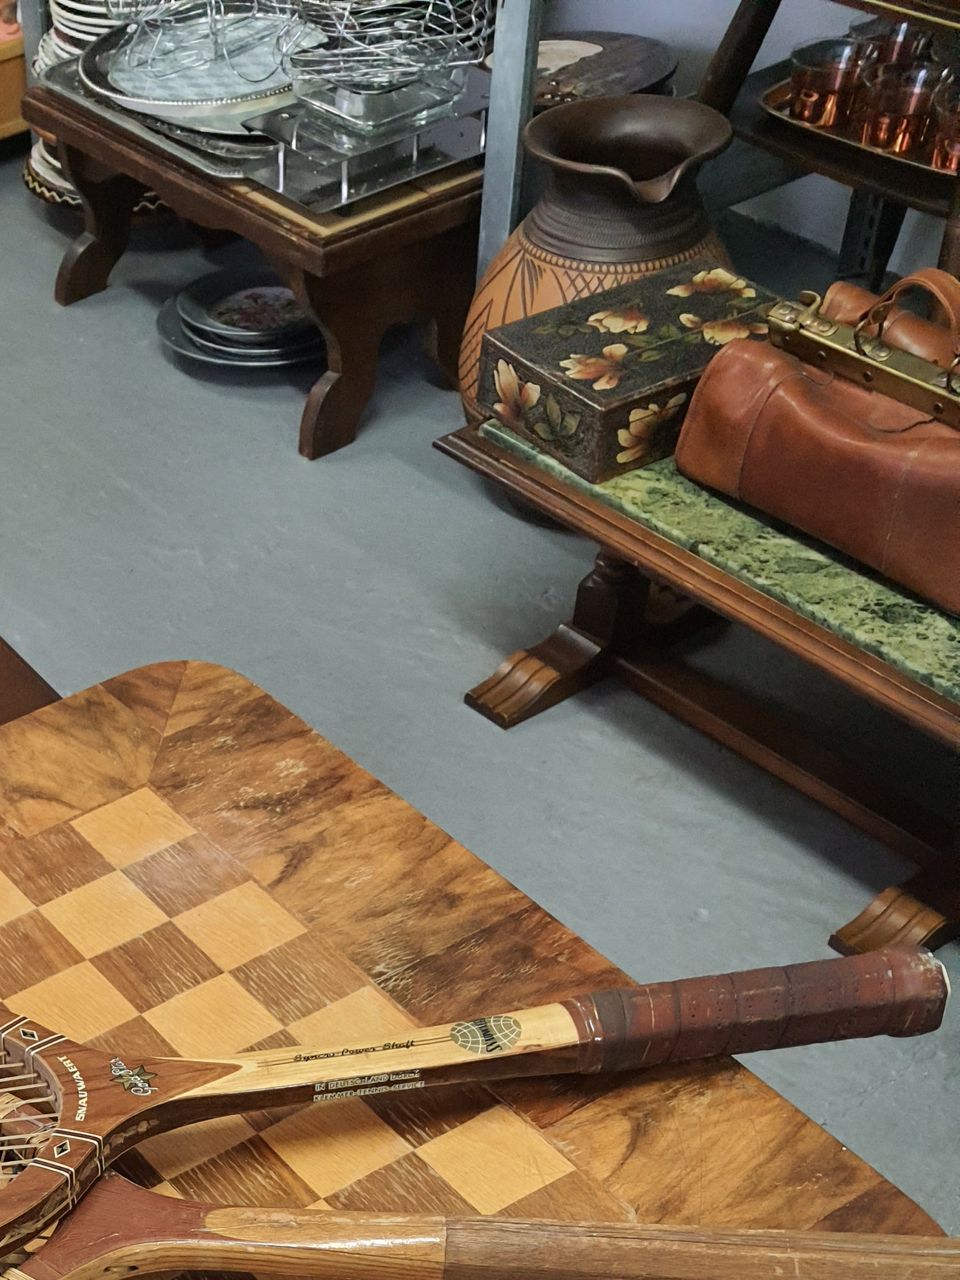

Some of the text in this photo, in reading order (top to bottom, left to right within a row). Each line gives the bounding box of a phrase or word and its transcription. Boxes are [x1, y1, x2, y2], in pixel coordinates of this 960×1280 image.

[341, 1048, 377, 1057] Power
[382, 1039, 415, 1050] Shaft
[57, 1056, 88, 1121] SNAUWAERT
[315, 1083, 326, 1092] IN
